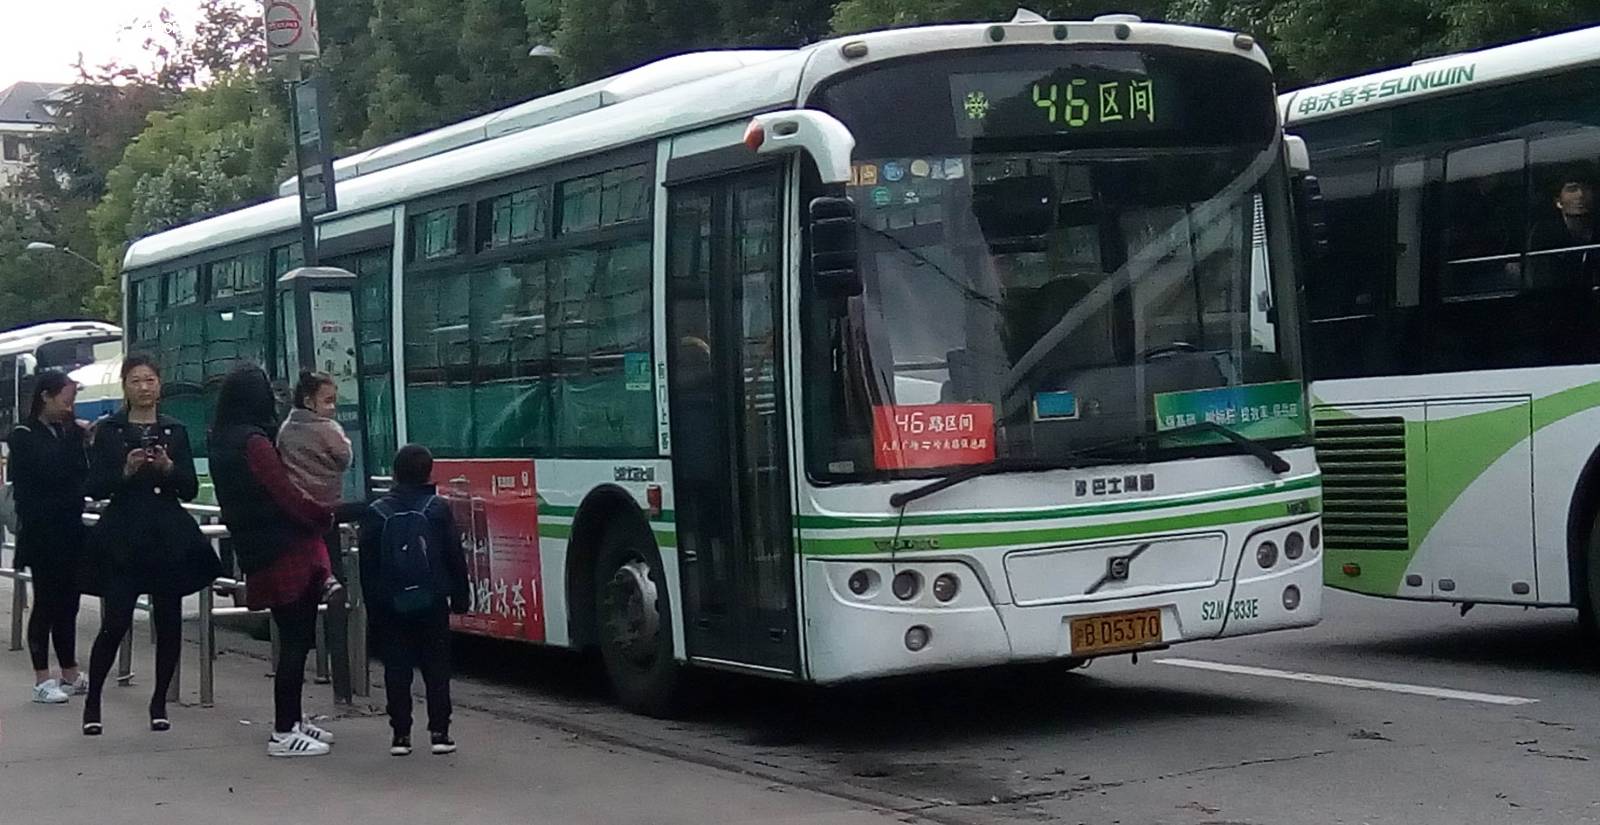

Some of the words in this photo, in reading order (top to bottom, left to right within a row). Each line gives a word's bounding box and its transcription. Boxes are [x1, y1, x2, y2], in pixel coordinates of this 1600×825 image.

[1033, 79, 1090, 127] 46
[1099, 79, 1154, 123] 区间
[1298, 80, 1379, 115] 申沃客车
[1379, 63, 1476, 98] SUNWIN
[895, 411, 924, 434] 46
[928, 413, 973, 433] 路区间
